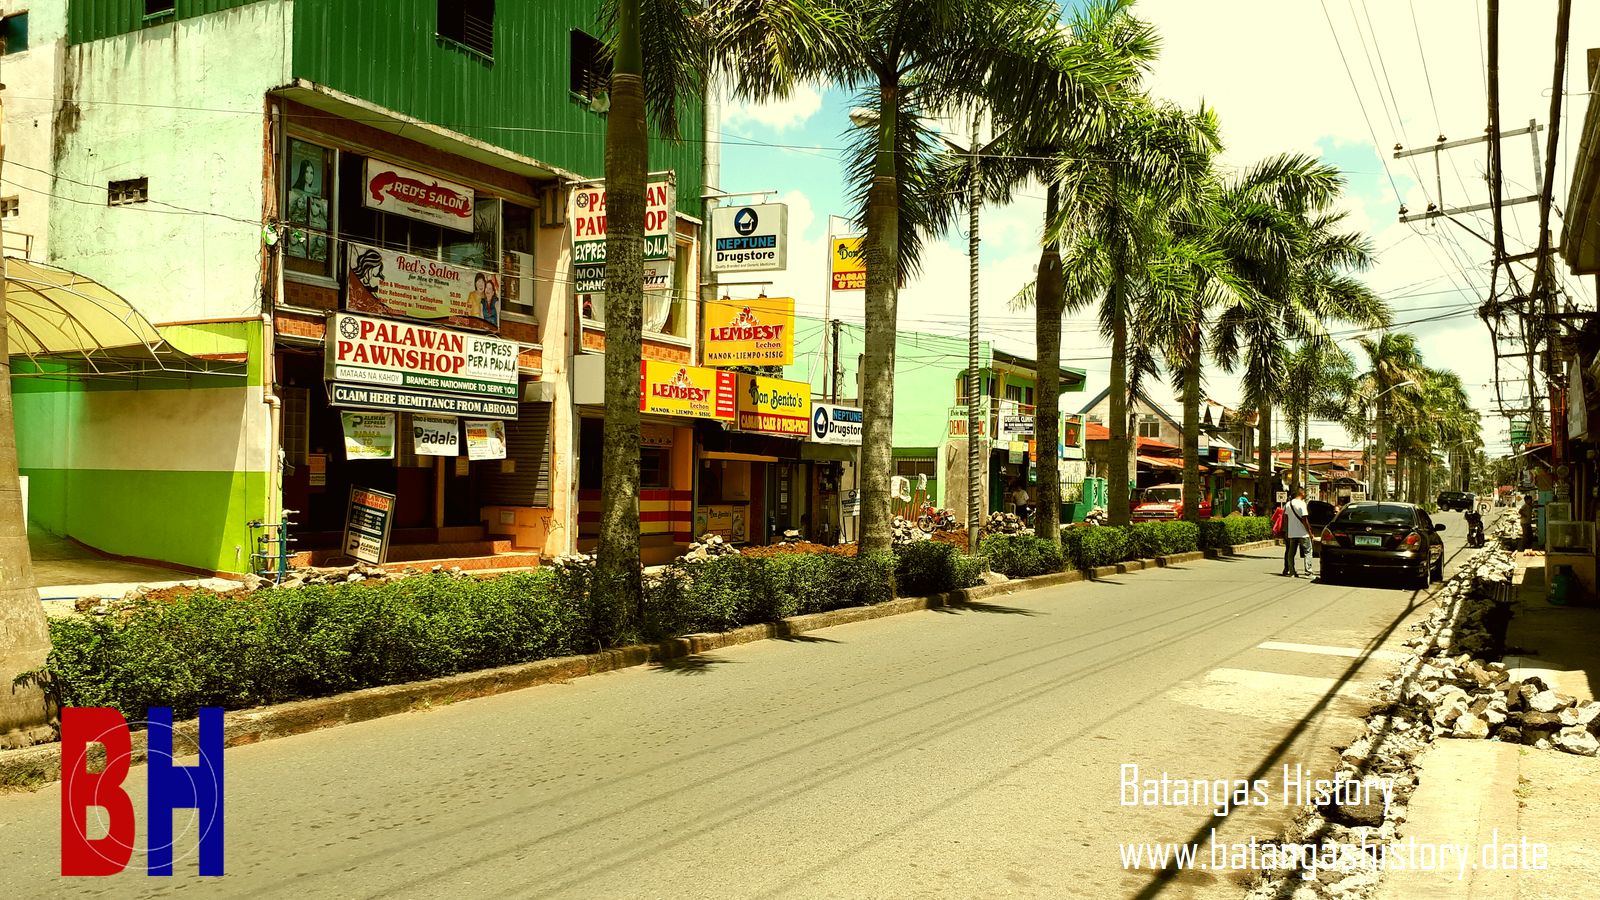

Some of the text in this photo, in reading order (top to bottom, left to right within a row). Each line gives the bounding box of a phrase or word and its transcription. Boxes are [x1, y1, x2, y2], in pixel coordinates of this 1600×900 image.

[394, 182, 464, 210] RED'S SALON
[575, 242, 607, 261] EXPRES
[717, 236, 775, 250] NEPTUNE
[716, 250, 775, 264] Drugstore
[396, 256, 460, 281] Red's Salon
[415, 303, 437, 312] Treatment
[360, 320, 465, 354] PALAWAN
[710, 325, 784, 341] LEMBEST
[338, 340, 467, 374] PAWNSHOP
[473, 341, 513, 357] EXPRESS
[708, 352, 732, 360] MANOK
[736, 351, 761, 359] LIEMPO
[468, 354, 516, 373] PERA PADALA
[340, 369, 400, 382] MATAAS NA KAHOY
[406, 375, 516, 395] BRANCHES NATIONWIDE TO SERVE YOU
[336, 388, 517, 415] CLAIM HERE REMITTANCE FROM ABROAD
[652, 383, 711, 402] LEMBEST
[751, 387, 769, 406] Don
[770, 389, 803, 410] Benito's
[690, 402, 710, 411] Lechon
[833, 408, 862, 423] NEPTUNE
